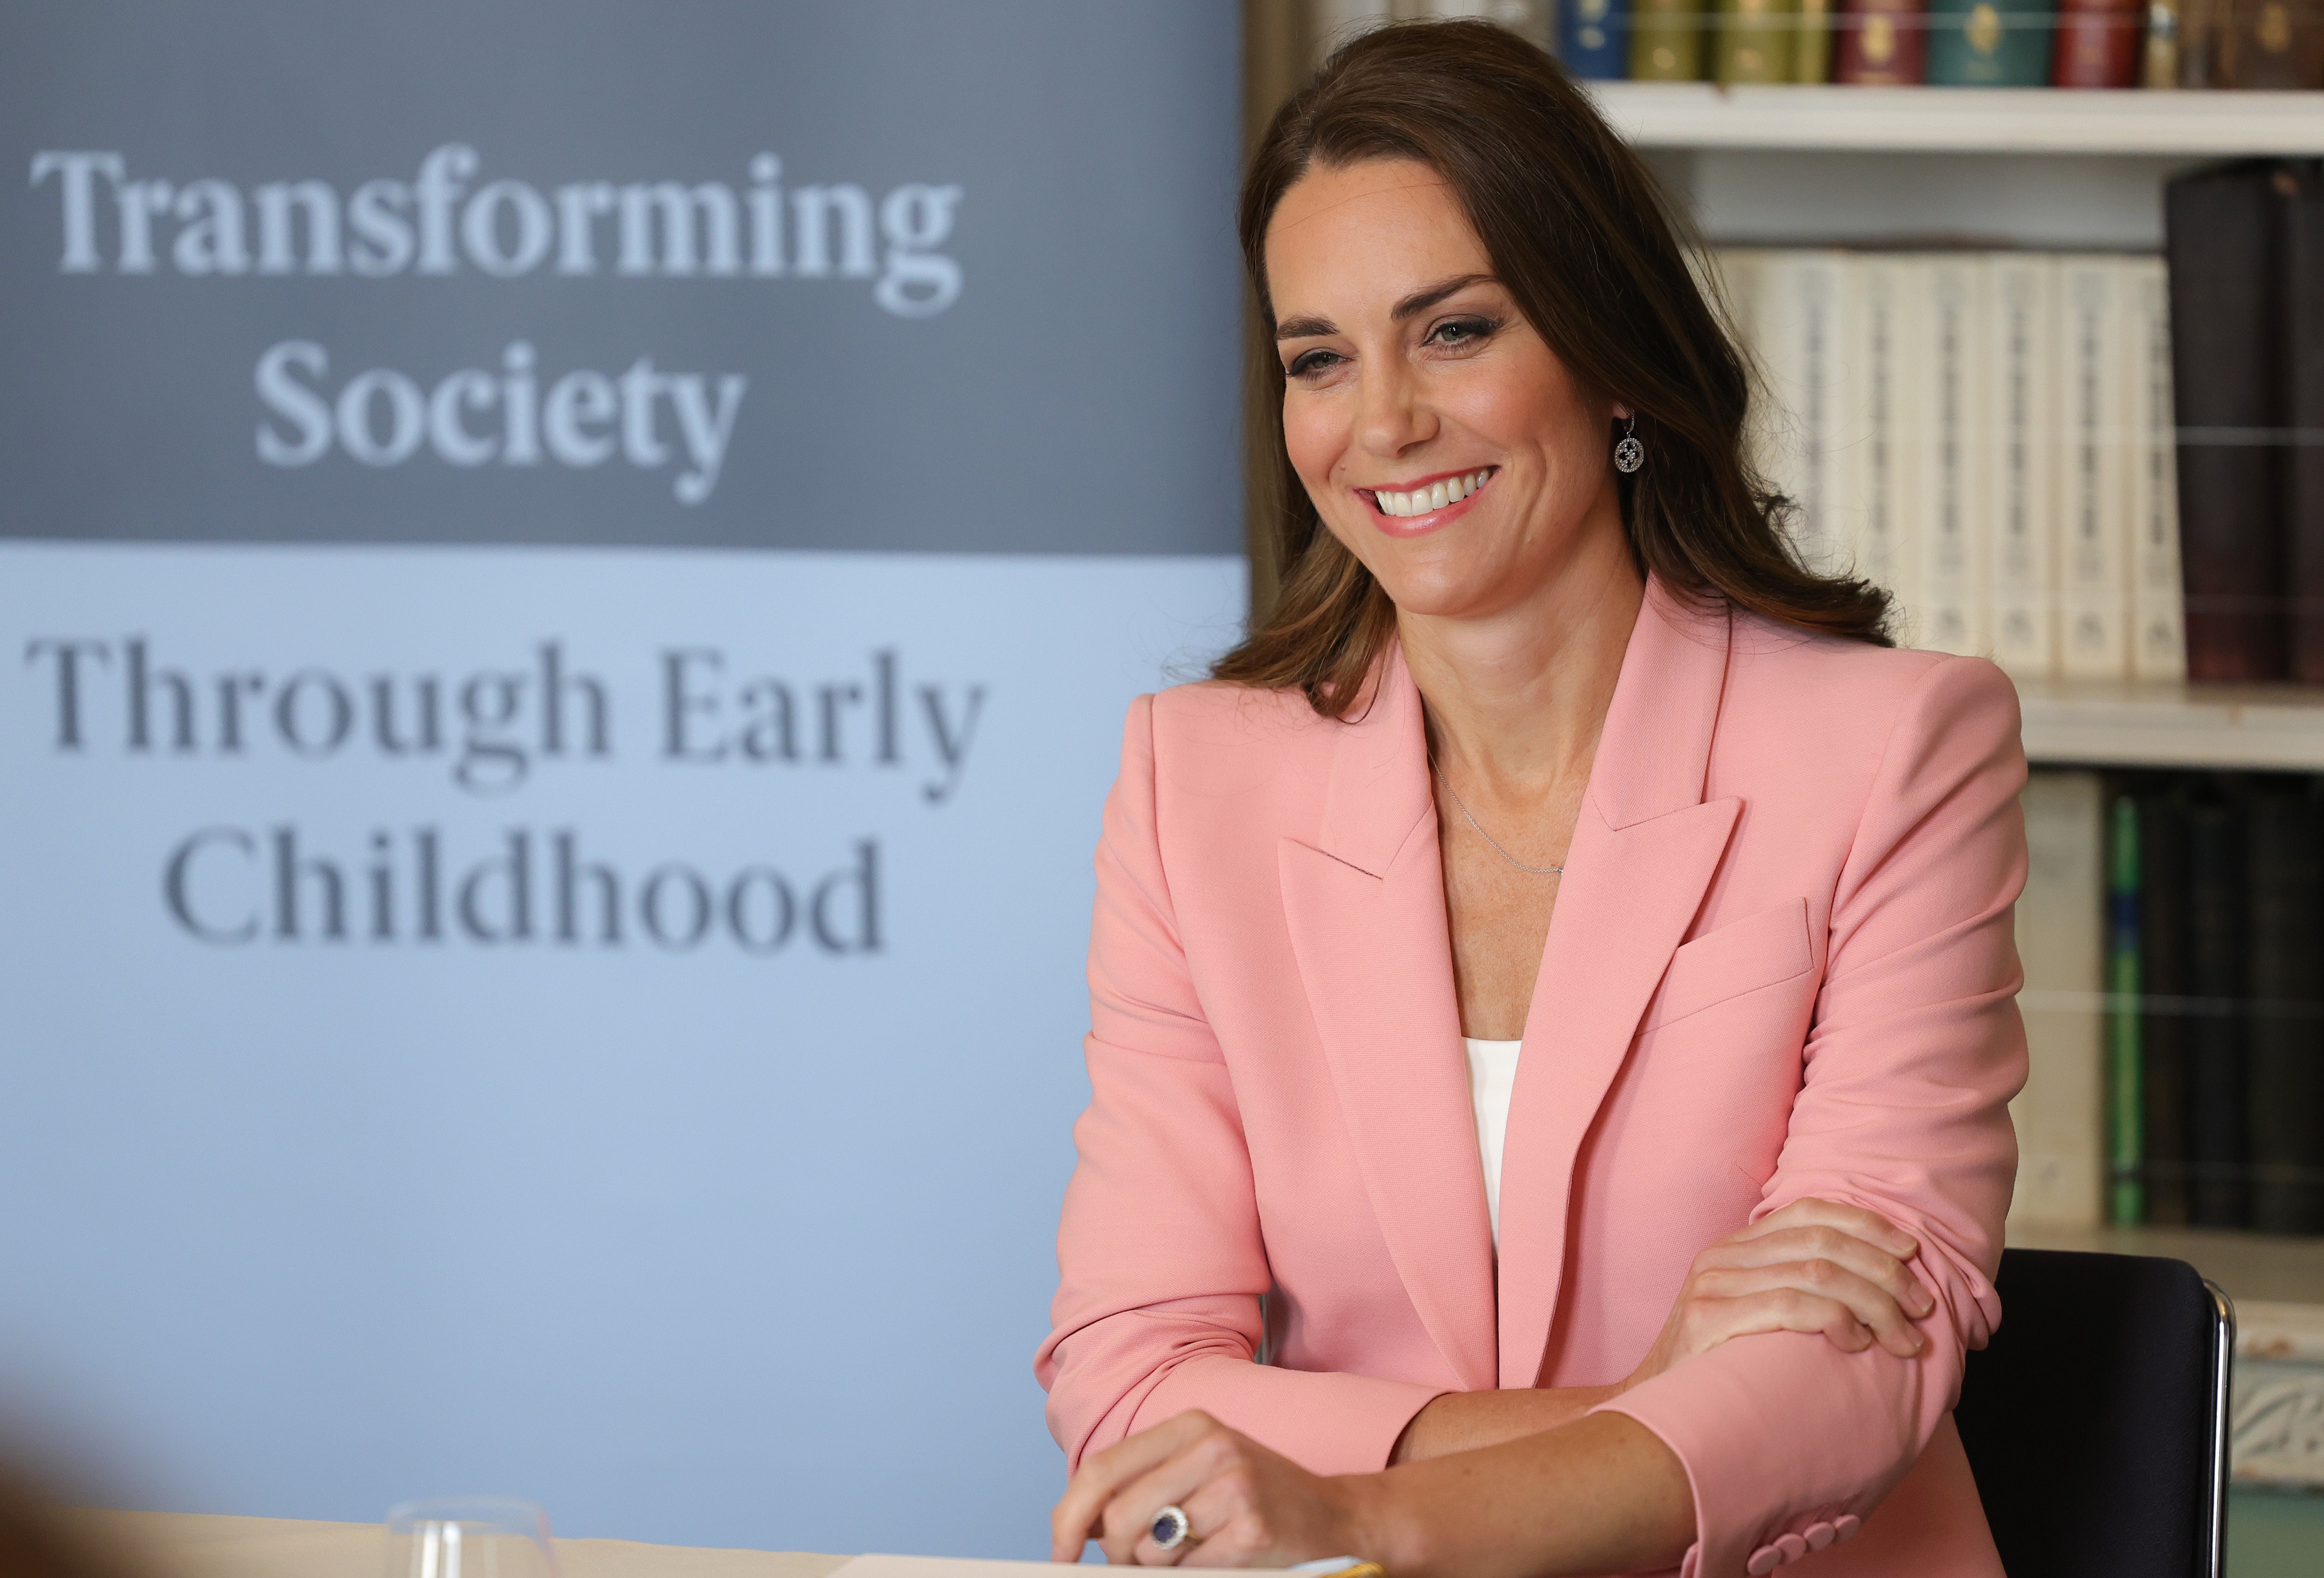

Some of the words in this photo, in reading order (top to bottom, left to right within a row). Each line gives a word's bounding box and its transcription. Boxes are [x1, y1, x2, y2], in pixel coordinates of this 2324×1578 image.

[32, 145, 963, 317] Transforming
[256, 342, 745, 504] Society
[25, 636, 611, 790] Through
[657, 647, 986, 806] Early
[161, 825, 885, 956] Childhood
